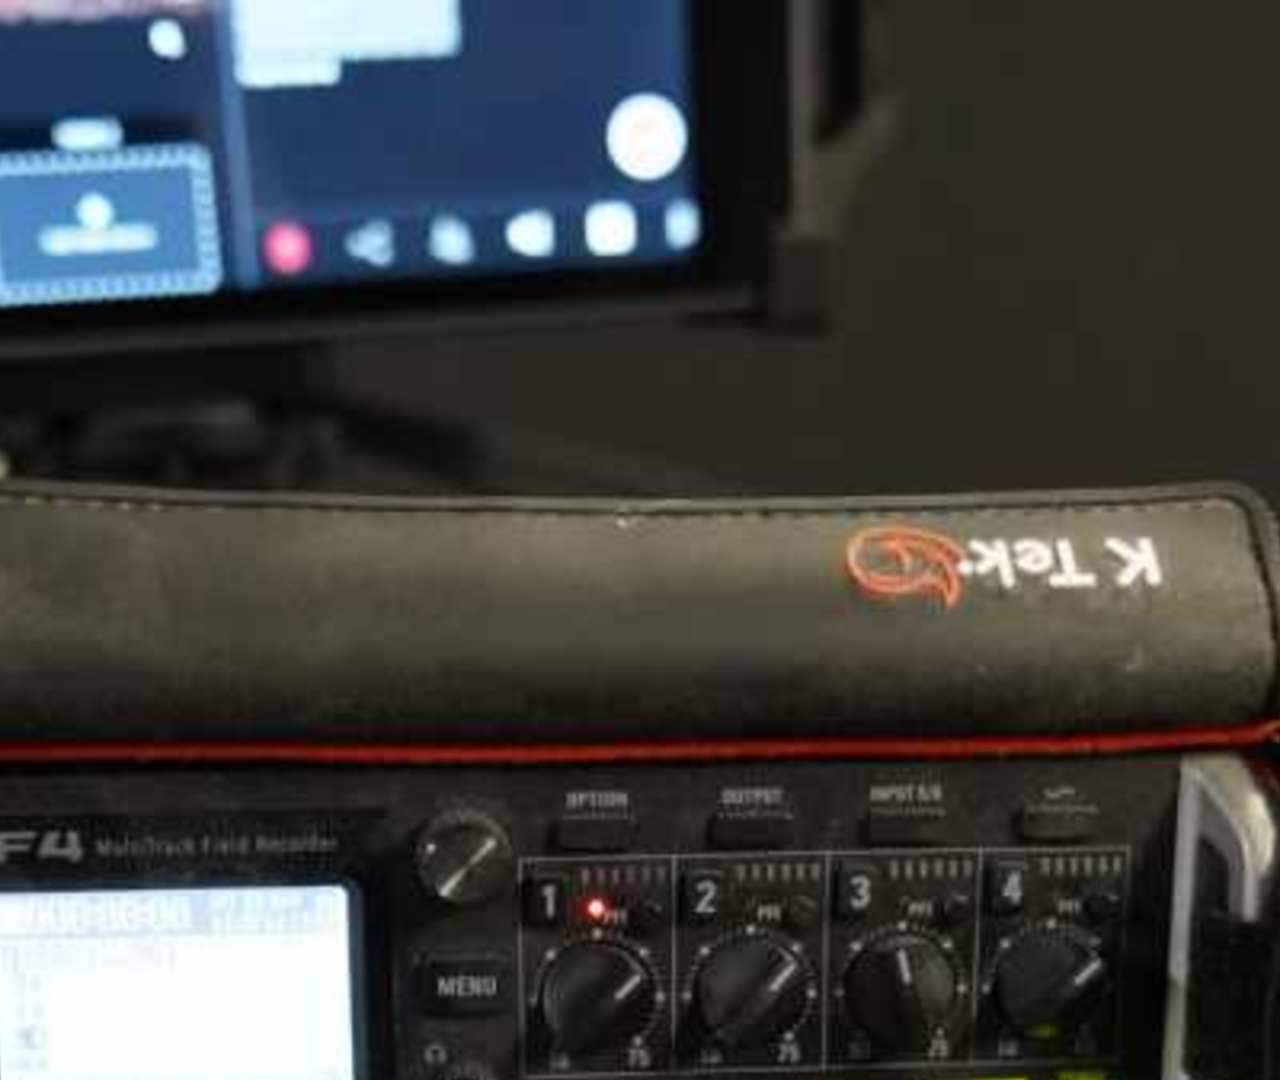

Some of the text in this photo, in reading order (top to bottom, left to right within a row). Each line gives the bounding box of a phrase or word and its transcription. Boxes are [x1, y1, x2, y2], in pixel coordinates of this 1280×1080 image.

[1105, 537, 1162, 586] K
[565, 791, 628, 808] OPTION
[721, 788, 782, 804] OUTPUT
[540, 883, 556, 919] 1
[694, 880, 718, 914] 2
[849, 874, 872, 910] 3
[1001, 870, 1023, 904] 4
[437, 976, 497, 997] MENU
